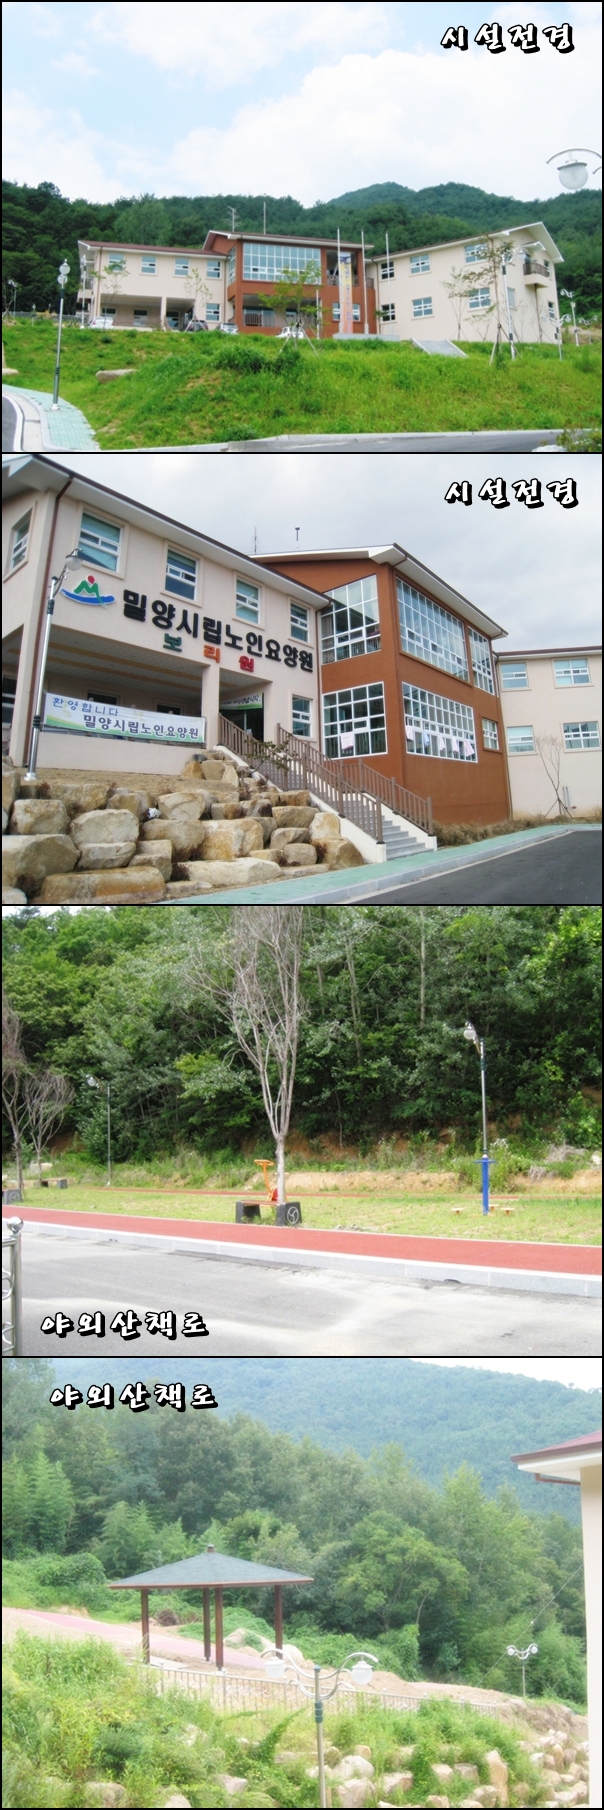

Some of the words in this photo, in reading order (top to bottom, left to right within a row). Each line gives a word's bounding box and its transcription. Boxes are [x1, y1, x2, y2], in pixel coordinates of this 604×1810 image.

[123, 589, 314, 672] 밀양시립노인요양원
[53, 697, 119, 717] 환영합니다
[83, 714, 199, 739] 밀양시립노인요양원
